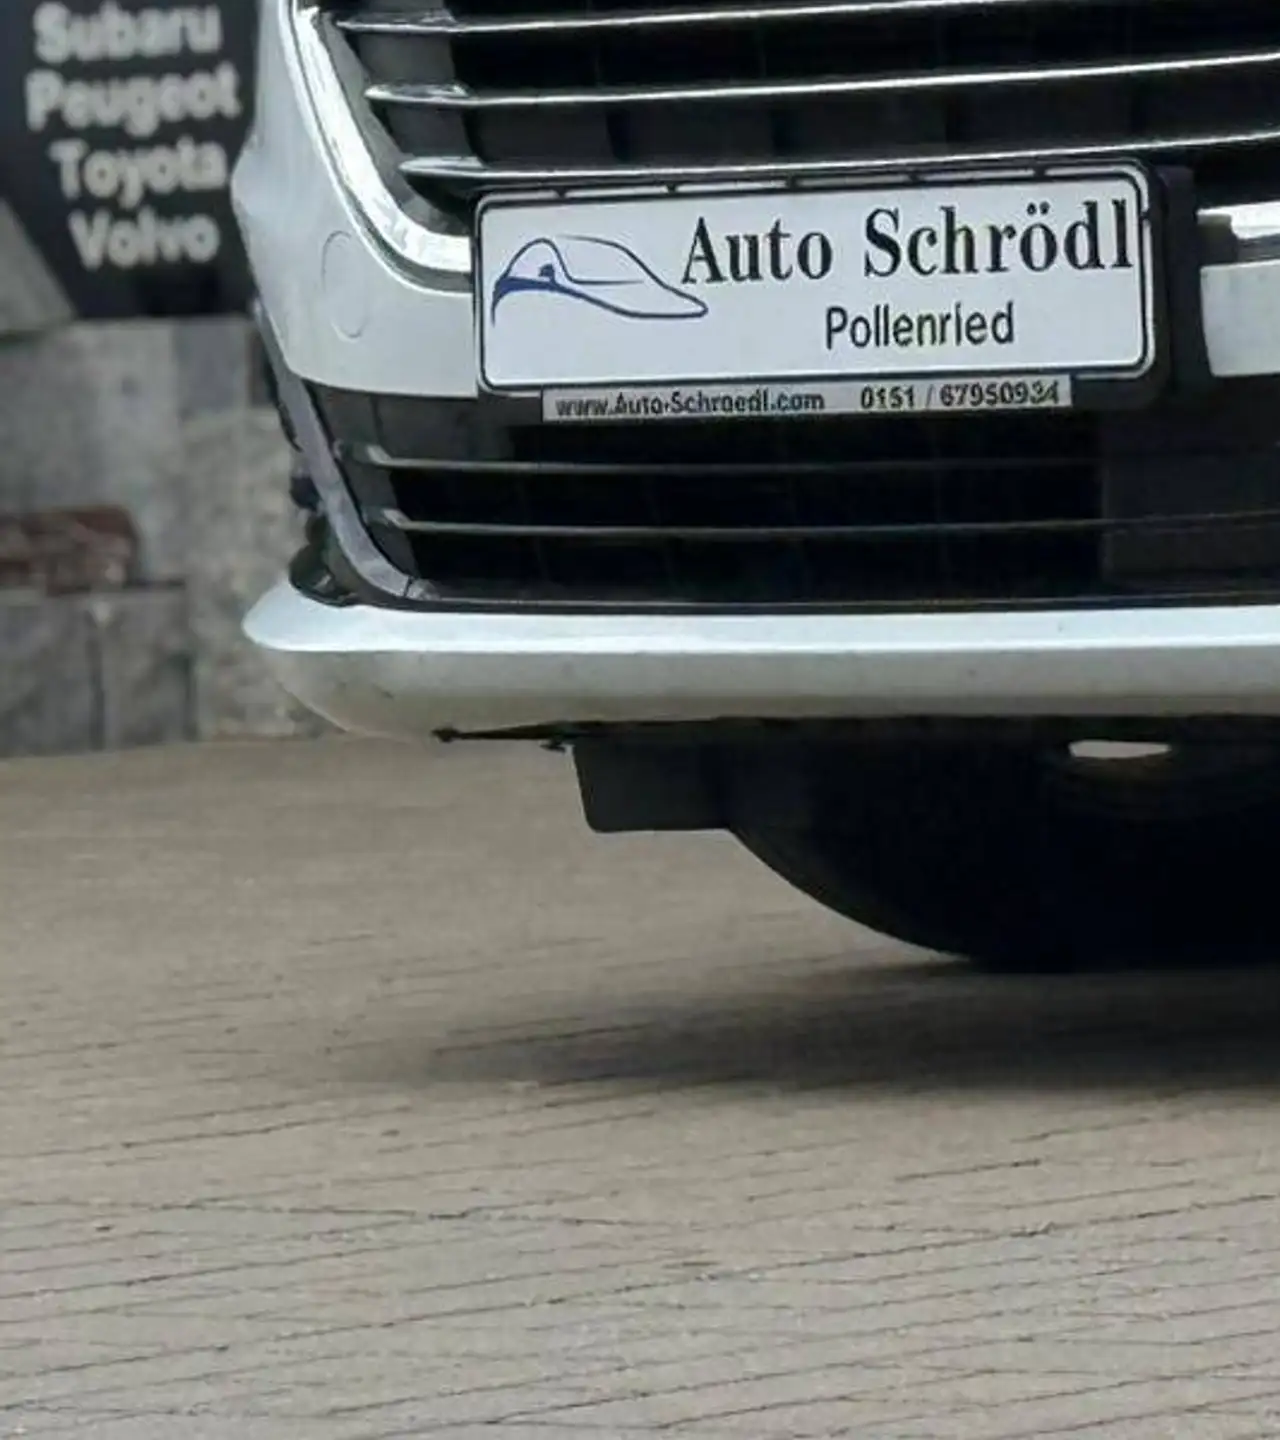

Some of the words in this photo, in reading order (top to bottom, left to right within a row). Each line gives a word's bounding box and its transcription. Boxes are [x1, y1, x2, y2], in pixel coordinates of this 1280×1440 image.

[34, 1, 222, 64] Subaru
[26, 62, 241, 137] Peugeot
[48, 136, 228, 209] Toyota
[69, 209, 220, 268] Volvo
[681, 215, 833, 285] Auto
[863, 198, 1134, 278] Schrödl
[825, 299, 1016, 350] Pollenried
[860, 384, 915, 410] 0151
[938, 379, 1060, 408] 67950934
